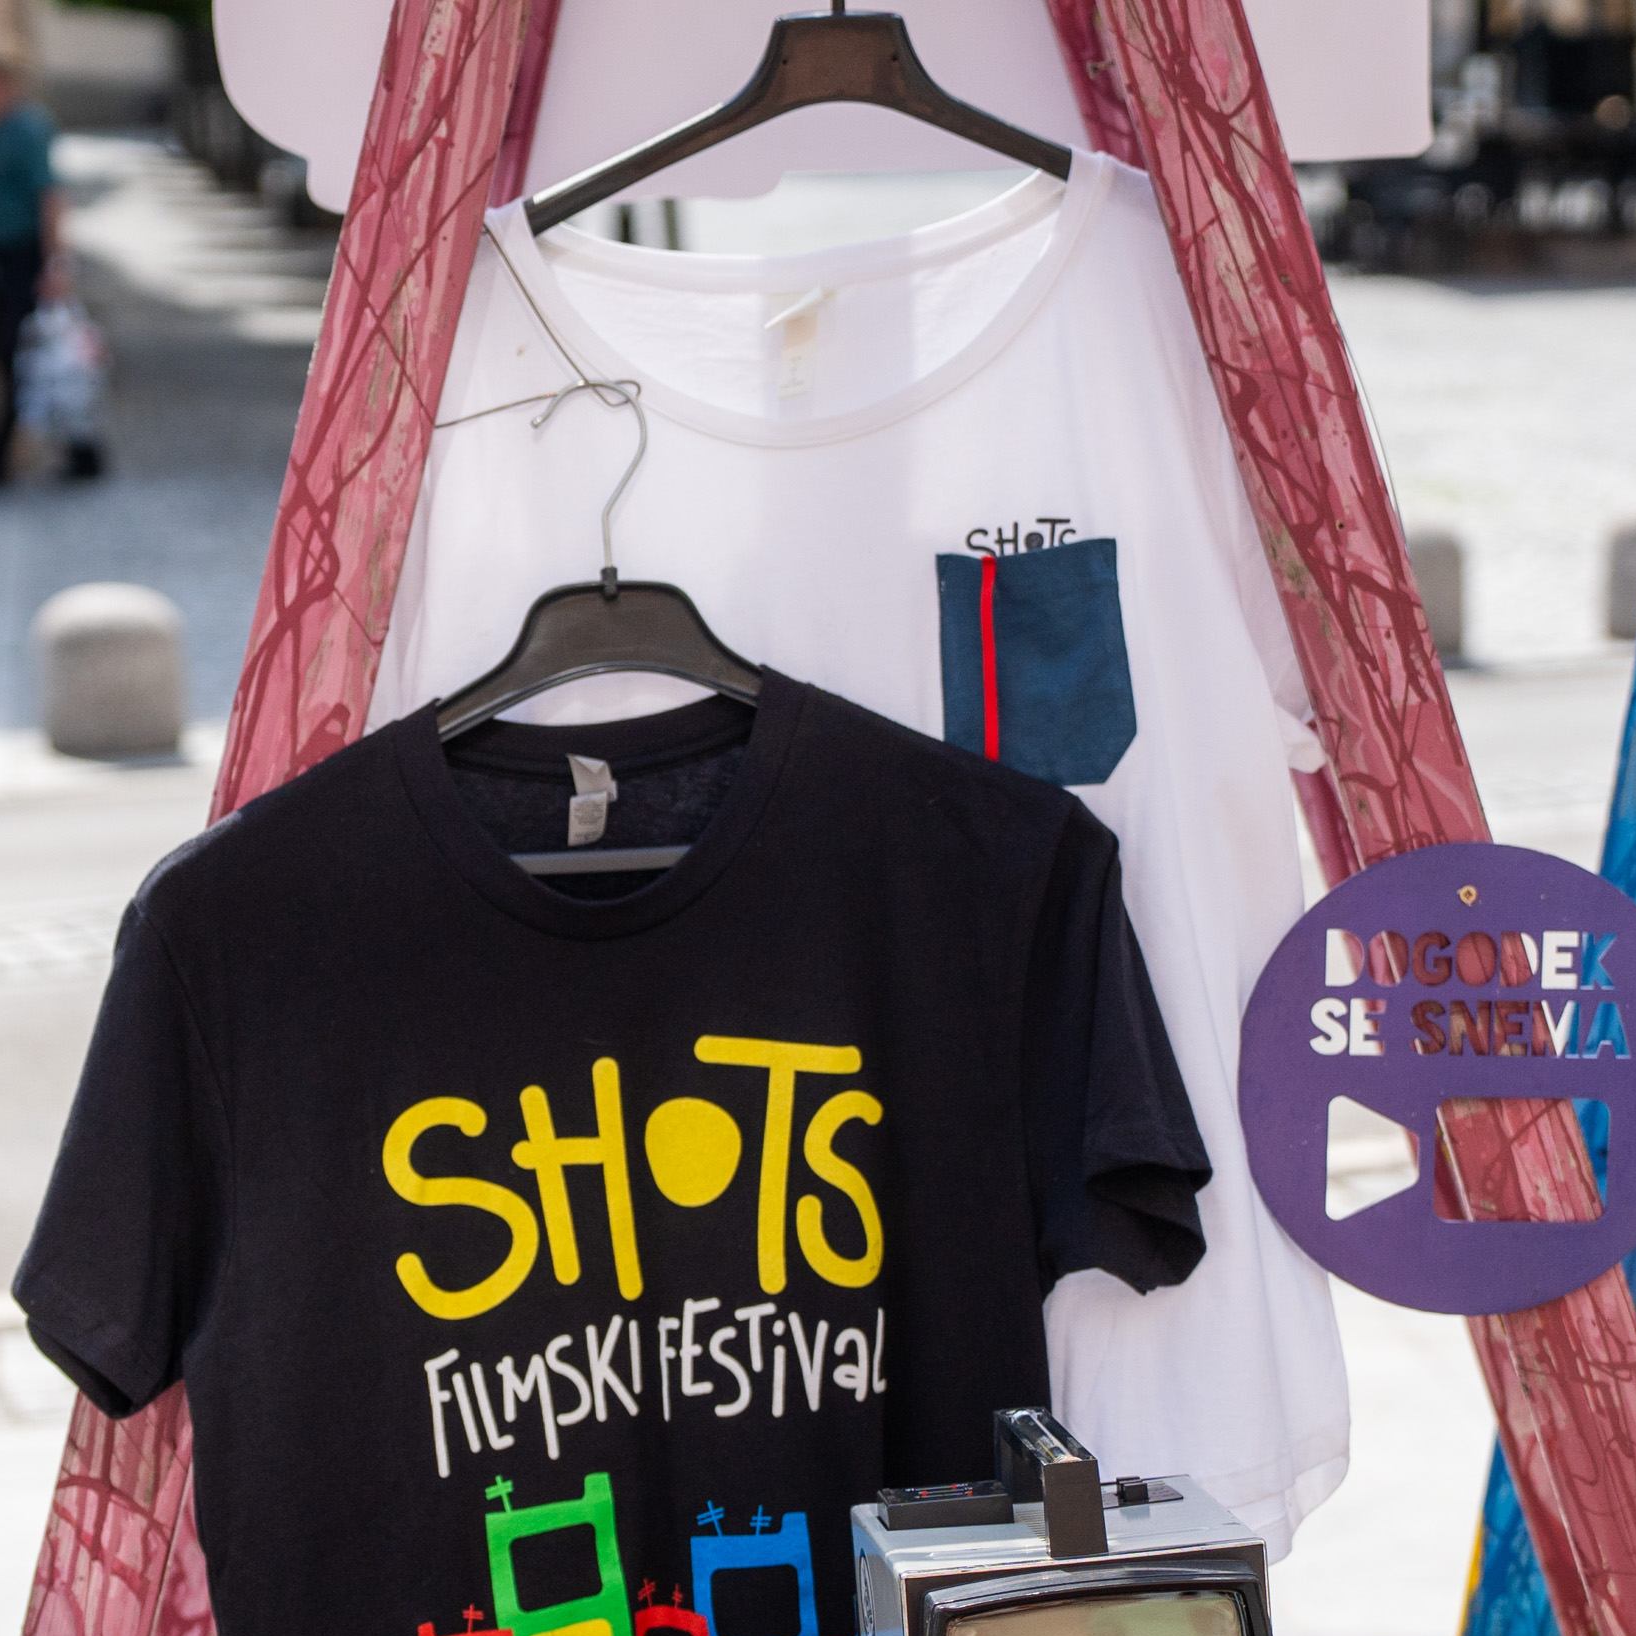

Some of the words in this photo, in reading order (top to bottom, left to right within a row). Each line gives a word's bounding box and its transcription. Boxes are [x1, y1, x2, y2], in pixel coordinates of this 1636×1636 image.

[965, 517, 1077, 557] SHOT
[1324, 927, 1618, 991] DOGODEK
[1308, 997, 1387, 1057] SE
[1410, 1000, 1632, 1060] SNEMA
[382, 1034, 885, 1321] SHOTS
[424, 1313, 643, 1478] FILMSKI
